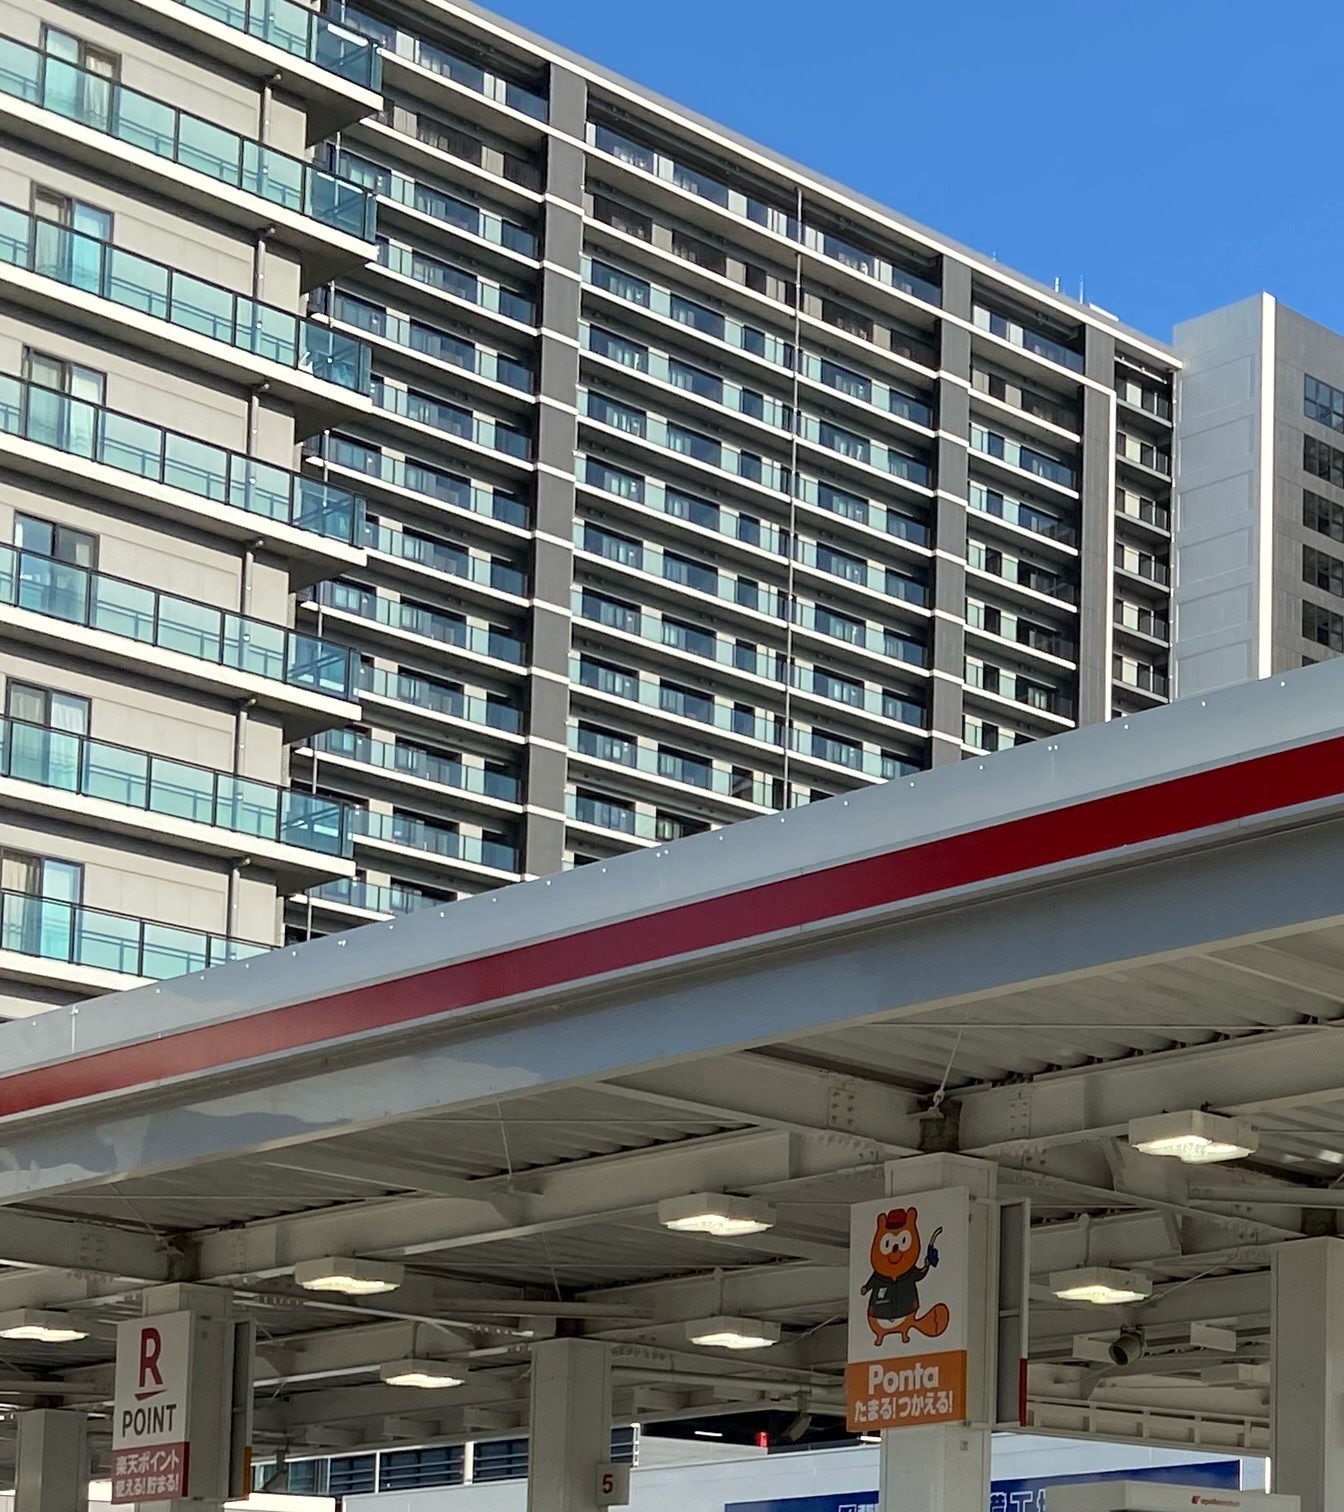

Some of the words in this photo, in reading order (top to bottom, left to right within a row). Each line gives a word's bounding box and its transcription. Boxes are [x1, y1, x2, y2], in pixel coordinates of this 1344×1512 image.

[139, 1327, 164, 1387] R
[868, 1362, 940, 1395] Ponta
[122, 1404, 177, 1438] POINT
[116, 1449, 180, 1476] 楽天ポイント
[603, 1474, 613, 1494] 5
